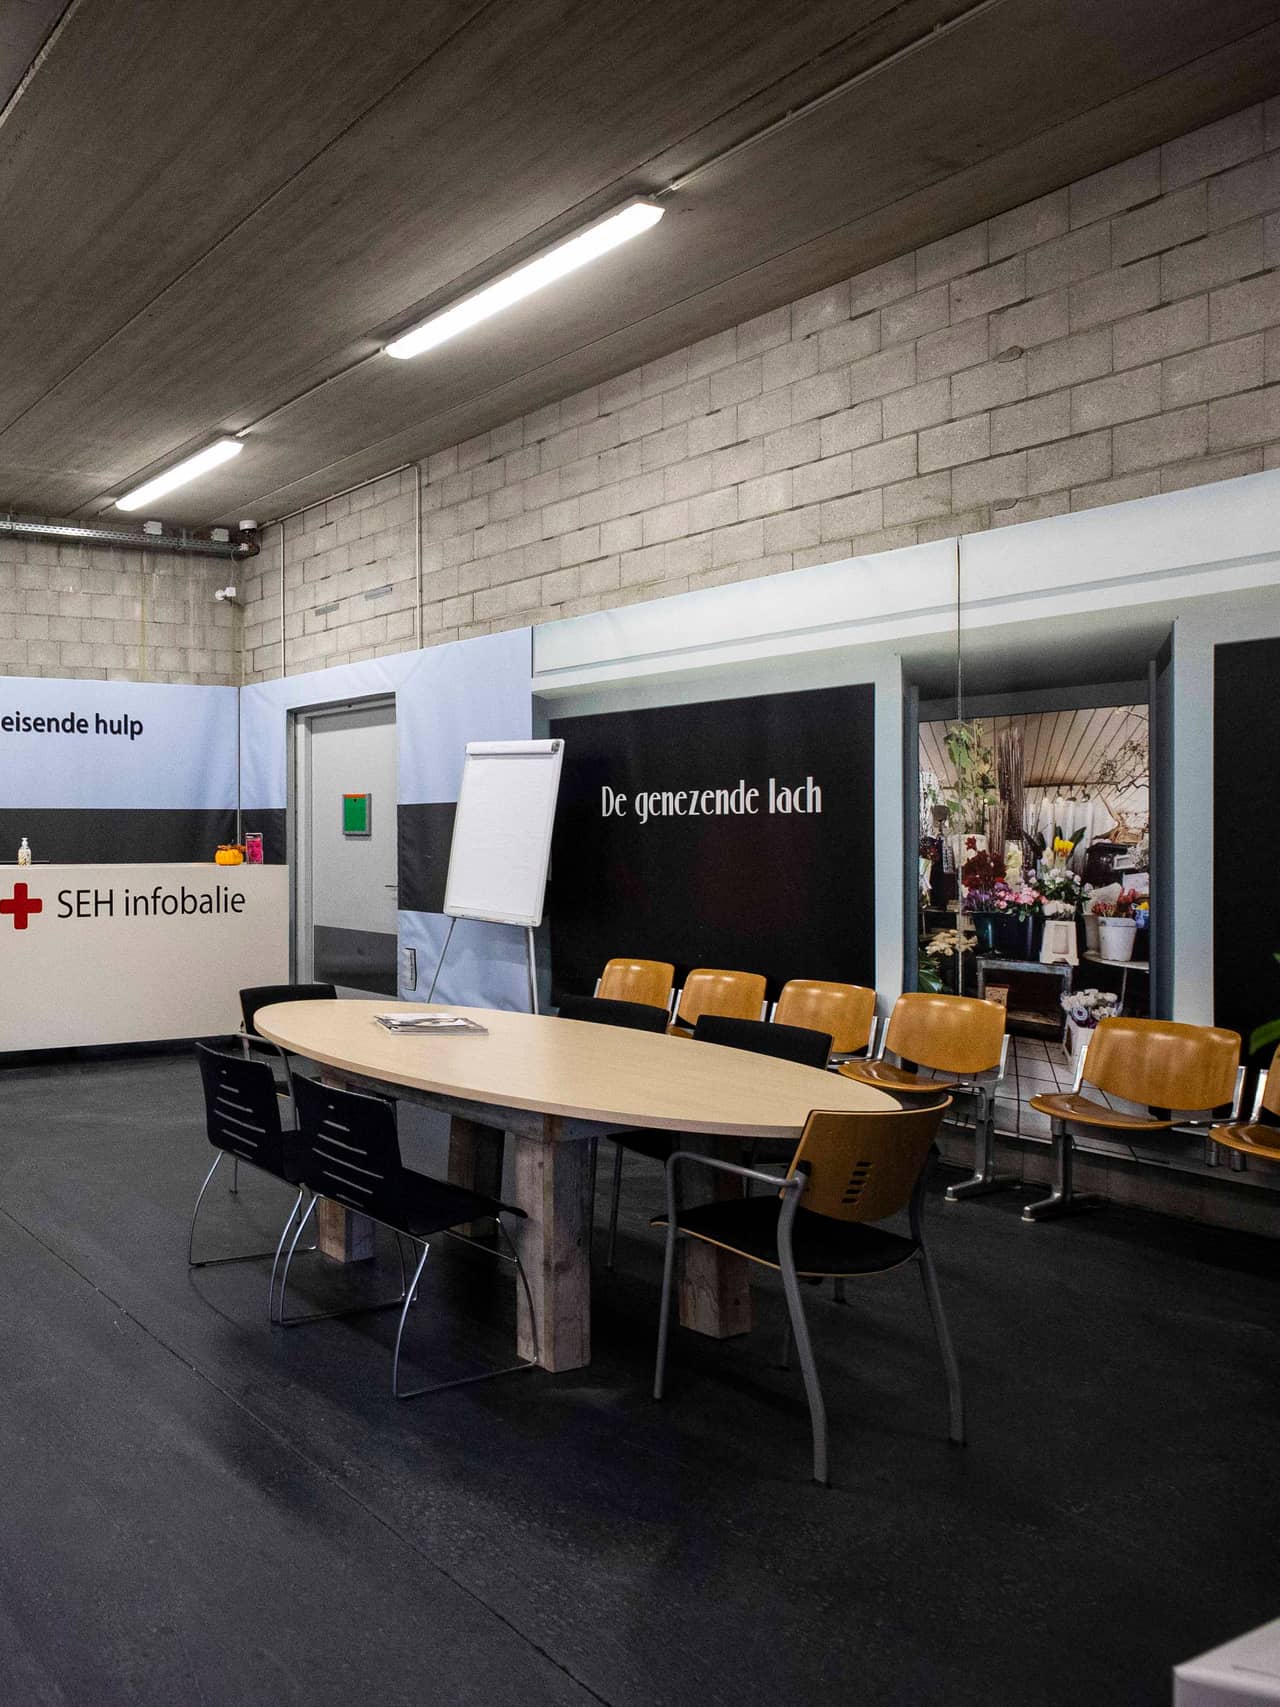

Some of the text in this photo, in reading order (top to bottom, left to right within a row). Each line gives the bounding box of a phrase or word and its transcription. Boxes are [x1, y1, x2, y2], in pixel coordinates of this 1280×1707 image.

[94, 712, 144, 741] hulp
[601, 776, 822, 824] De genezende lach
[57, 885, 246, 919] SEH infobalie
